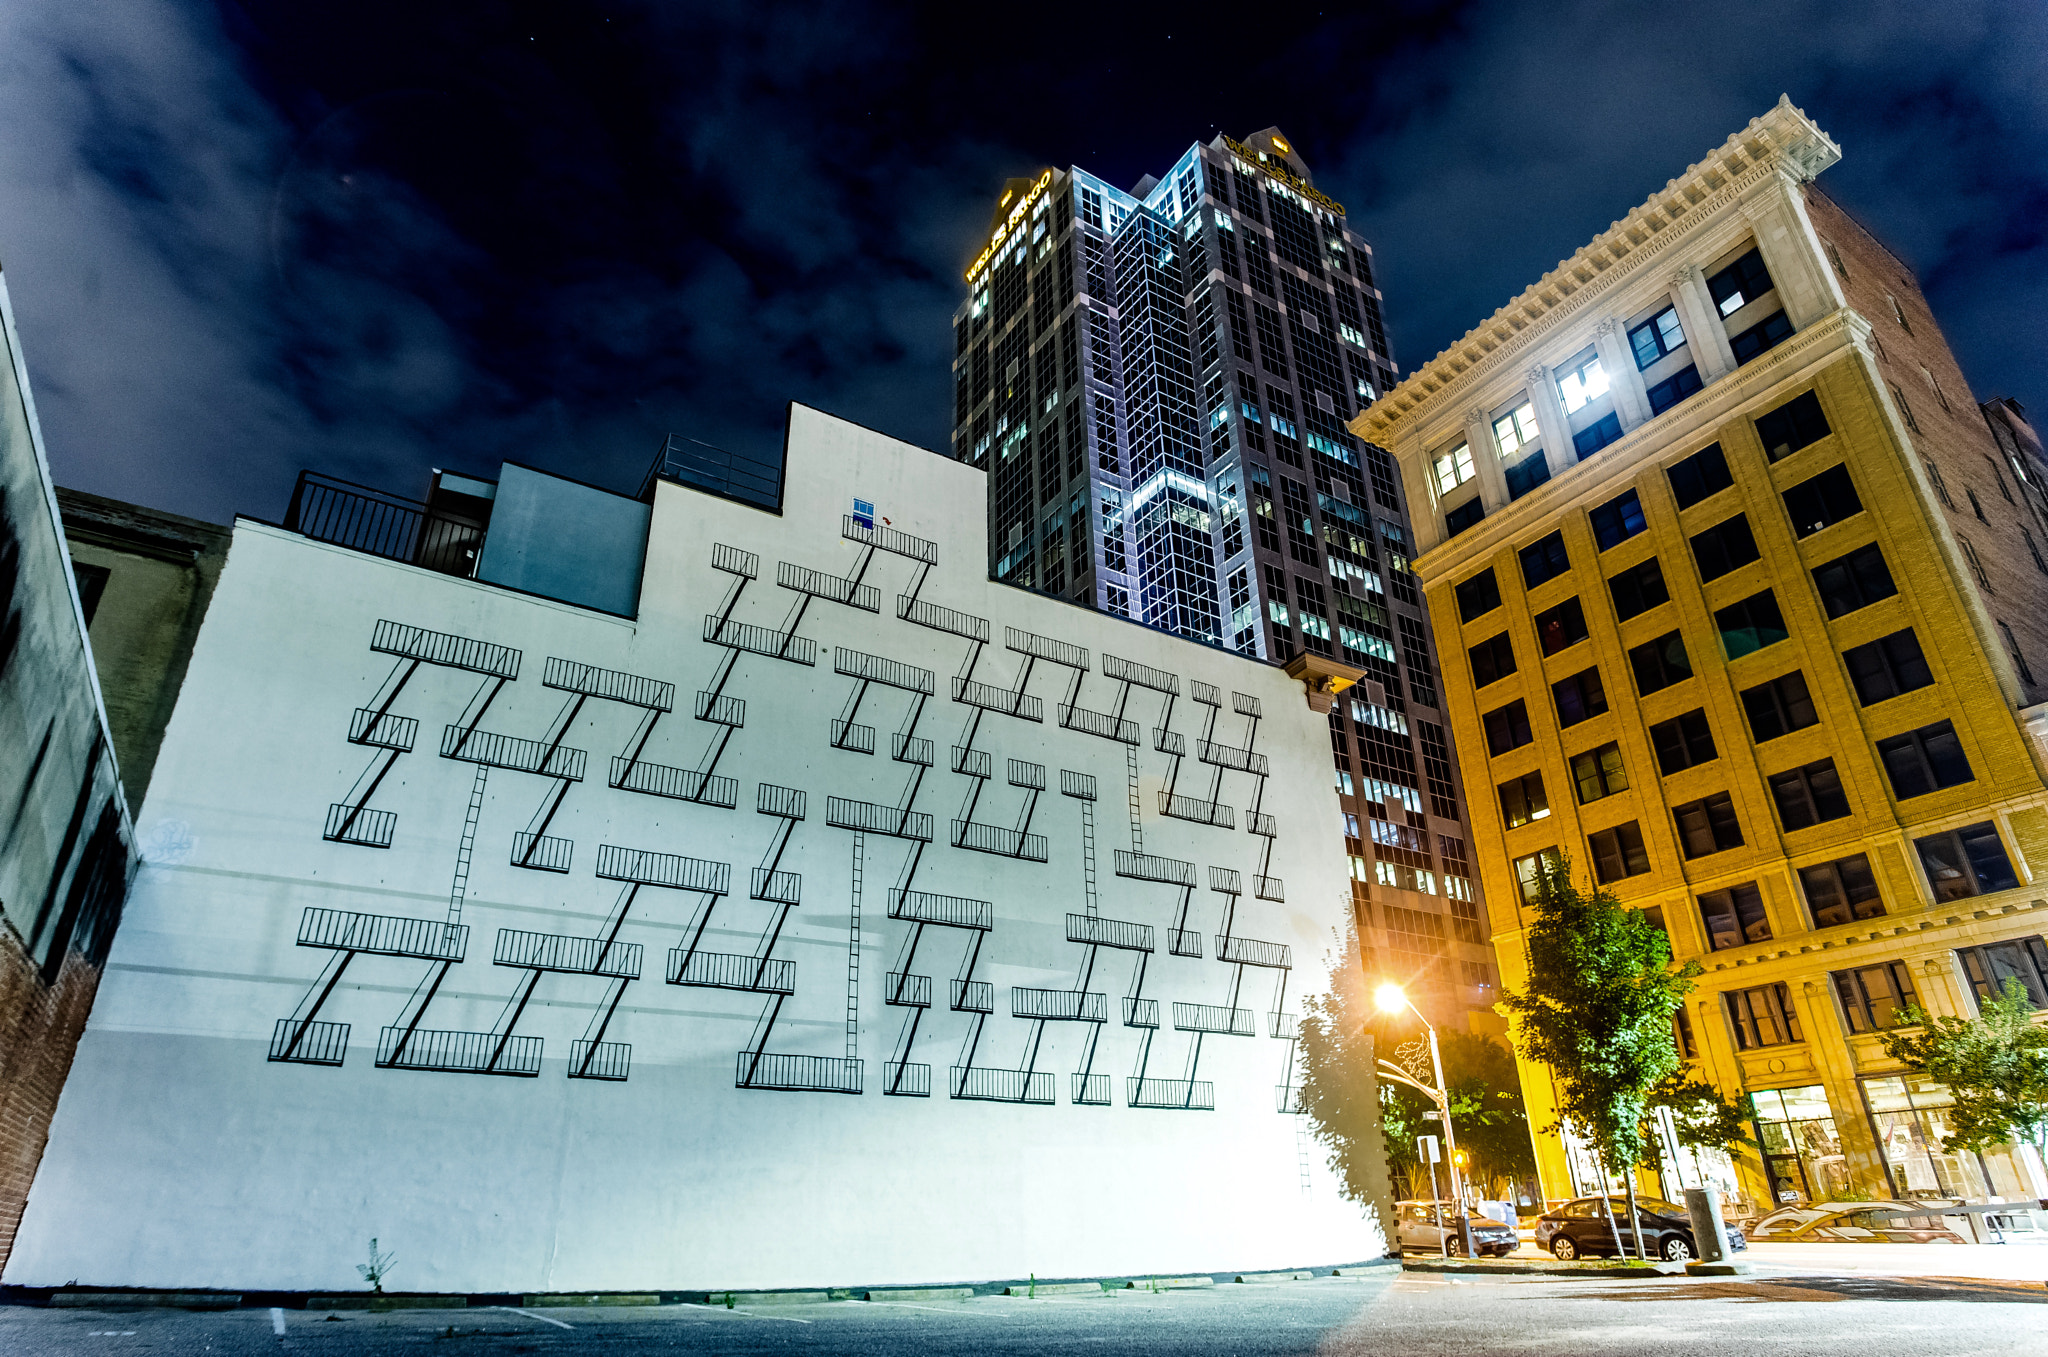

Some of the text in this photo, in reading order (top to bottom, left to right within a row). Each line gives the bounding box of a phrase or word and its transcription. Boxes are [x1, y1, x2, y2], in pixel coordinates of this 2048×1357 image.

[1224, 135, 1346, 216] WELLS FARGO
[966, 170, 1051, 282] WELLS FARGO
